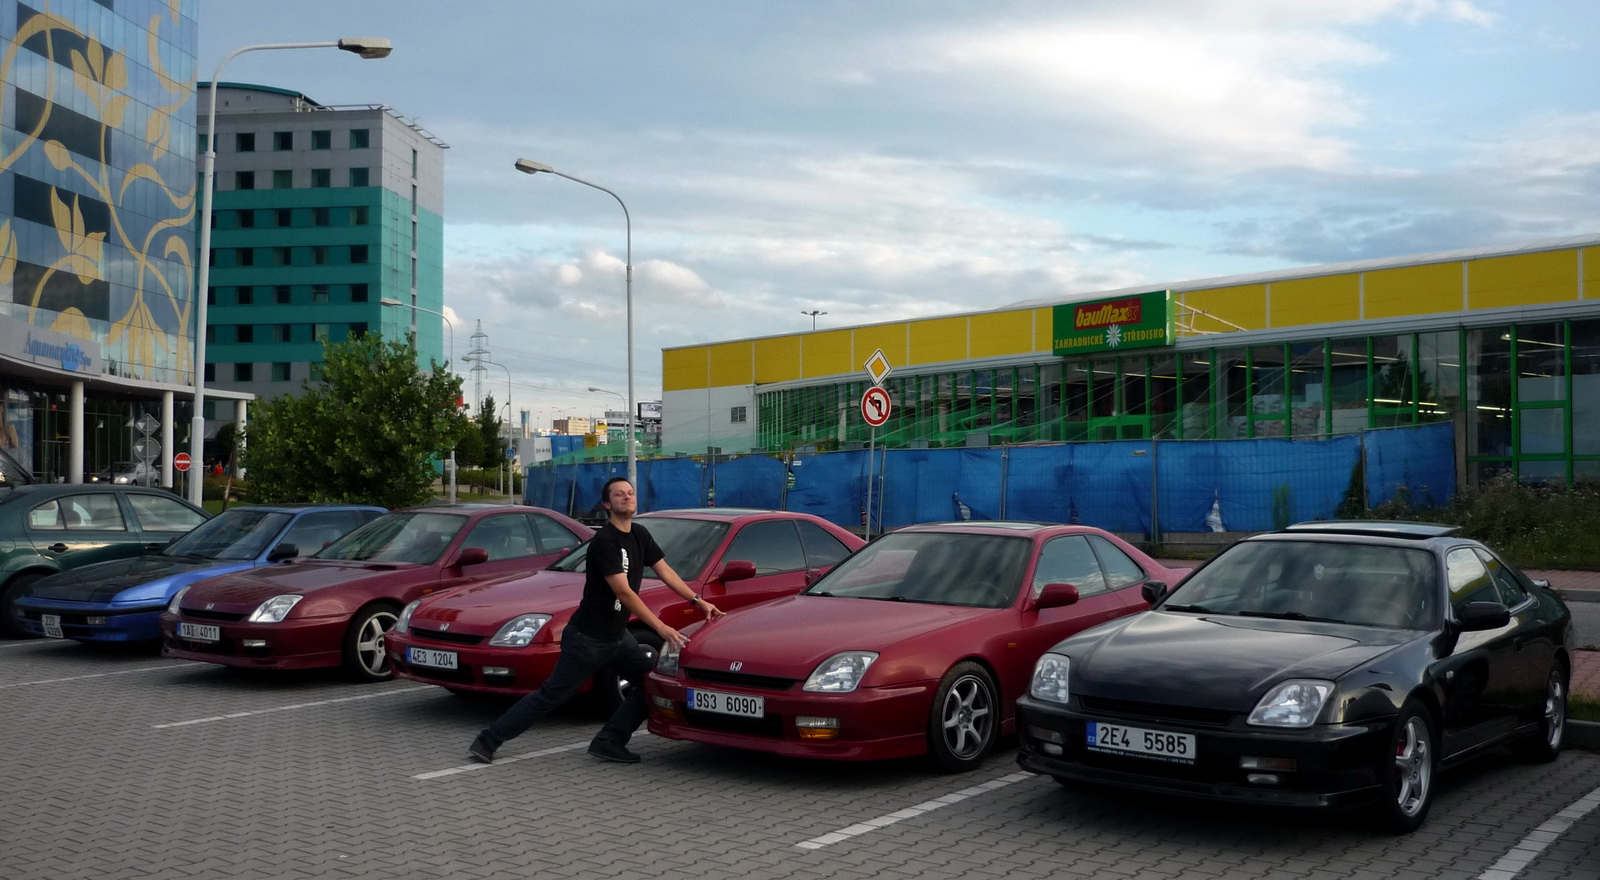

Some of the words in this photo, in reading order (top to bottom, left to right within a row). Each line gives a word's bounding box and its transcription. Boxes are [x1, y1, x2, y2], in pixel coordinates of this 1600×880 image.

[1054, 333, 1104, 350] ZAHRADNICKÉ
[1123, 328, 1164, 342] STŘEDISKO
[200, 626, 217, 639] 4011
[412, 649, 427, 663] 4E3
[433, 652, 454, 667] 1204
[696, 692, 717, 709] 9S3
[726, 696, 757, 714] 6090
[1100, 726, 1130, 747] 2E4
[1144, 731, 1187, 755] 5585
